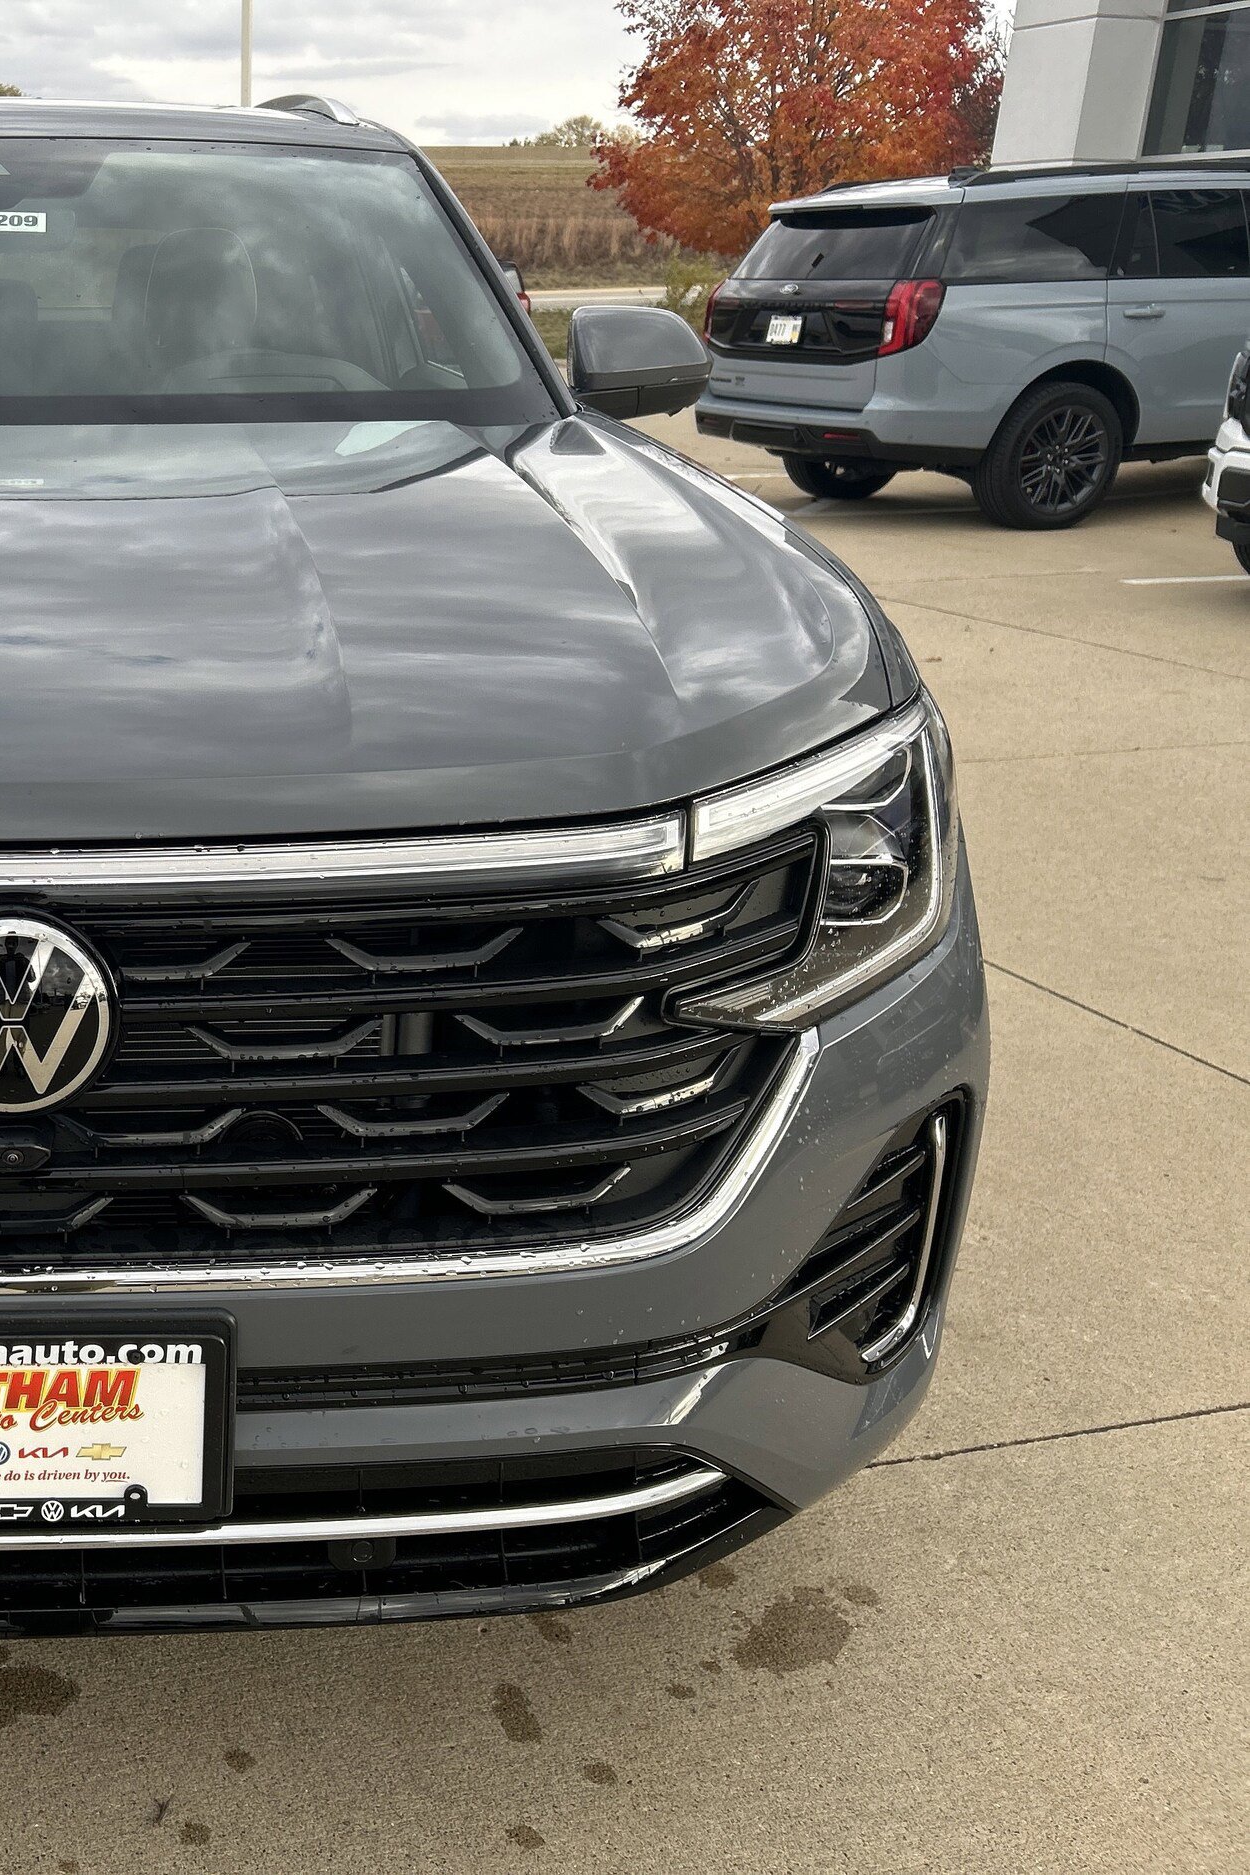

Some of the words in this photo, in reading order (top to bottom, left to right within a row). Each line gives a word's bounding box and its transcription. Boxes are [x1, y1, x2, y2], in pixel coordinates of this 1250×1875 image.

[29, 1399, 145, 1432] Centers
[3, 1470, 21, 1481] do
[24, 1470, 35, 1481] is
[37, 1469, 81, 1481] driven
[83, 1469, 100, 1483] by
[101, 1470, 131, 1483] you.
[42, 1501, 63, 1520] VW
